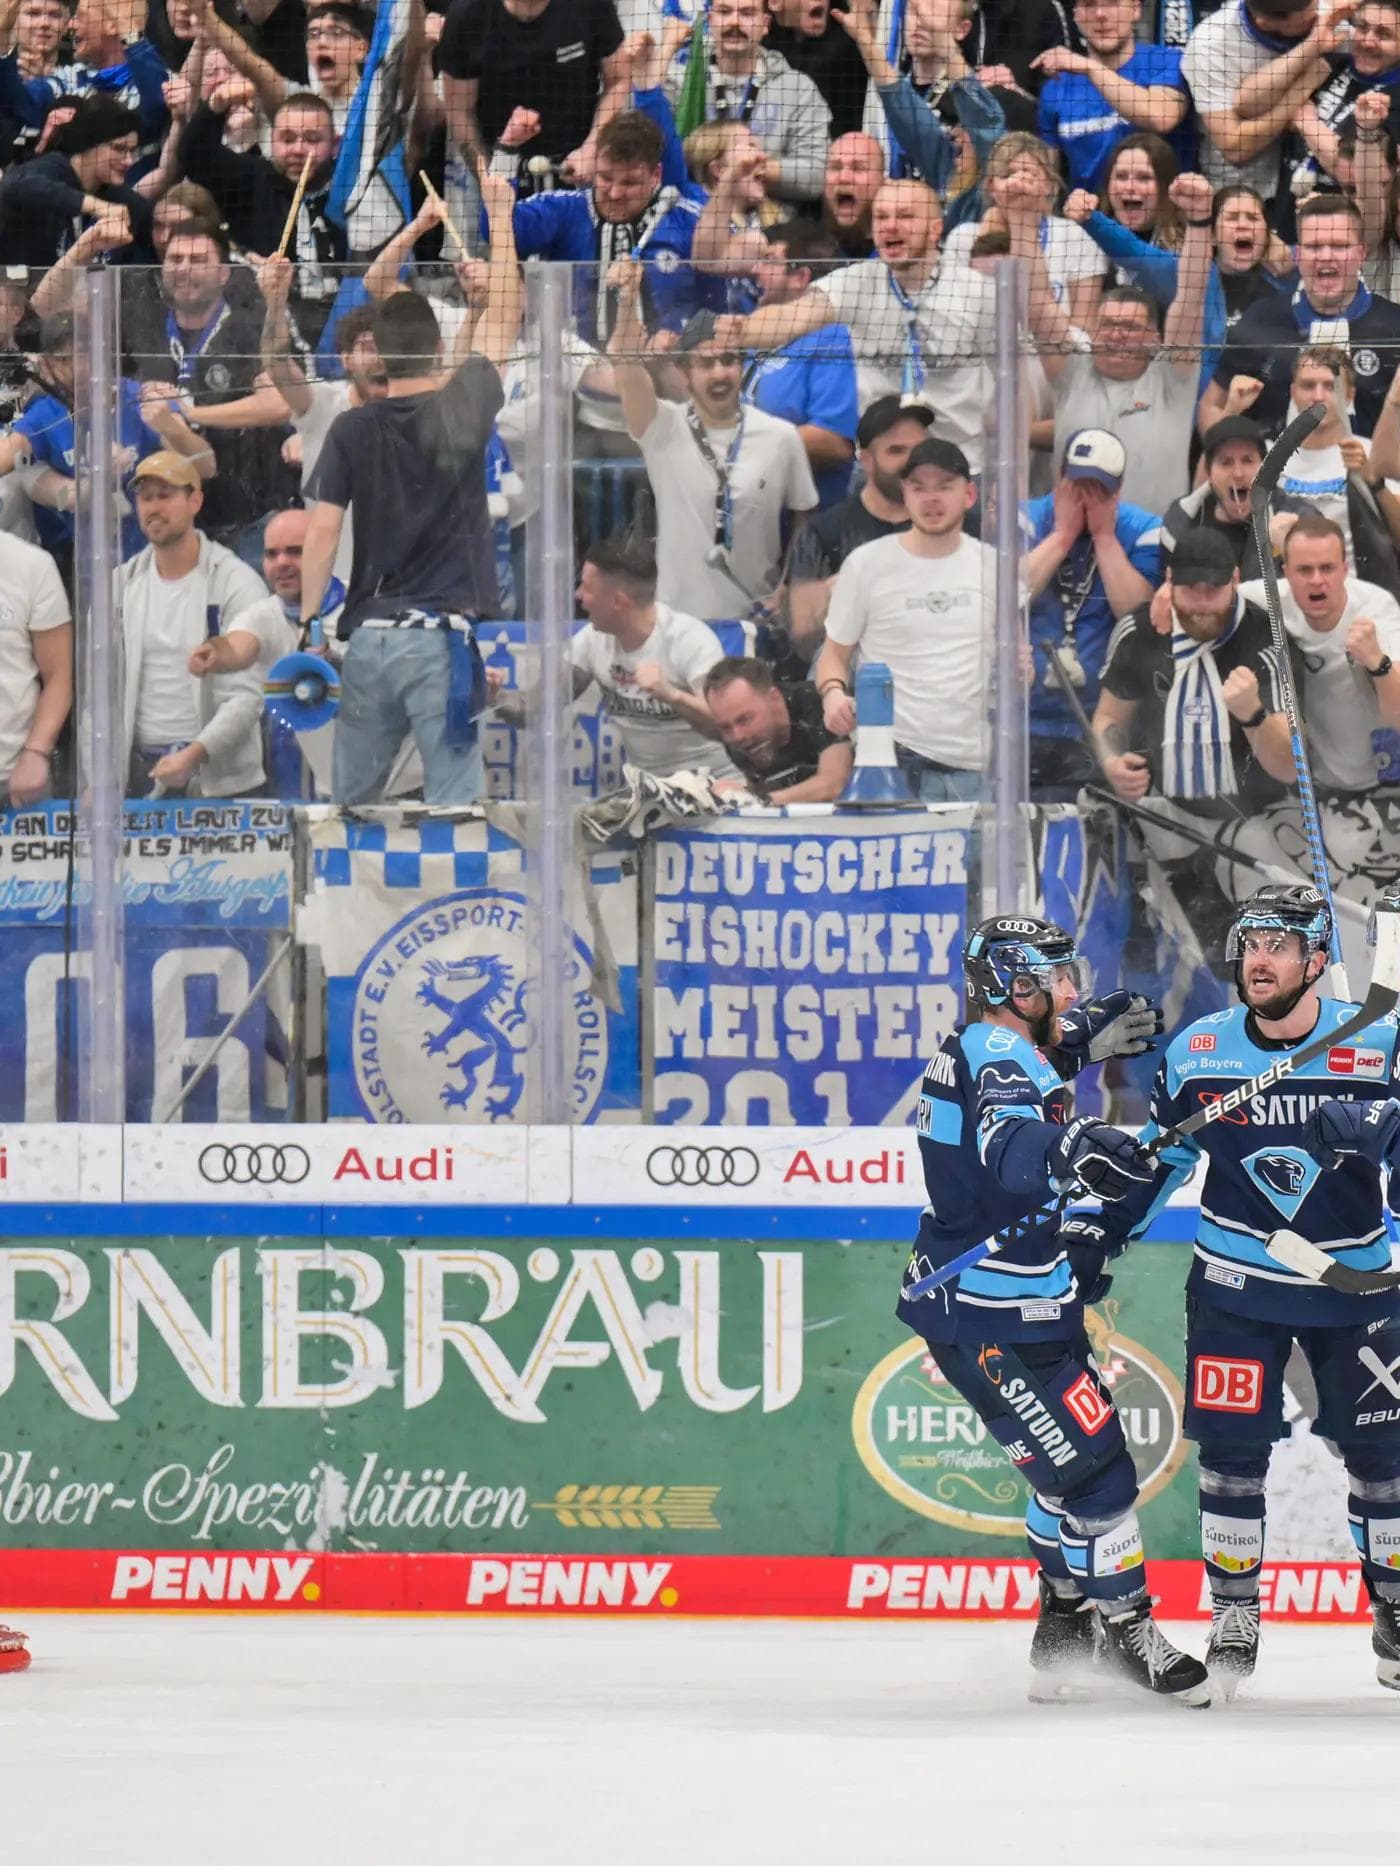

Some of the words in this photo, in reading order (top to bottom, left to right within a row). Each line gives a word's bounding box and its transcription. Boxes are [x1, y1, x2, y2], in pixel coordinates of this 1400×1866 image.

[176, 807, 242, 831] LAUT
[138, 838, 172, 857] ES
[180, 834, 257, 854] IMMER
[655, 831, 967, 896] DEUTSCHER
[655, 902, 960, 976] EISHOCKEY
[655, 984, 960, 1062] MEISTER
[1190, 1035, 1212, 1049] DB
[1199, 1057, 1244, 1069] Bayern
[333, 1146, 455, 1183] Audi
[783, 1149, 905, 1185] Audi
[1201, 1365, 1255, 1404] DB
[1001, 1378, 1077, 1467] SATURN
